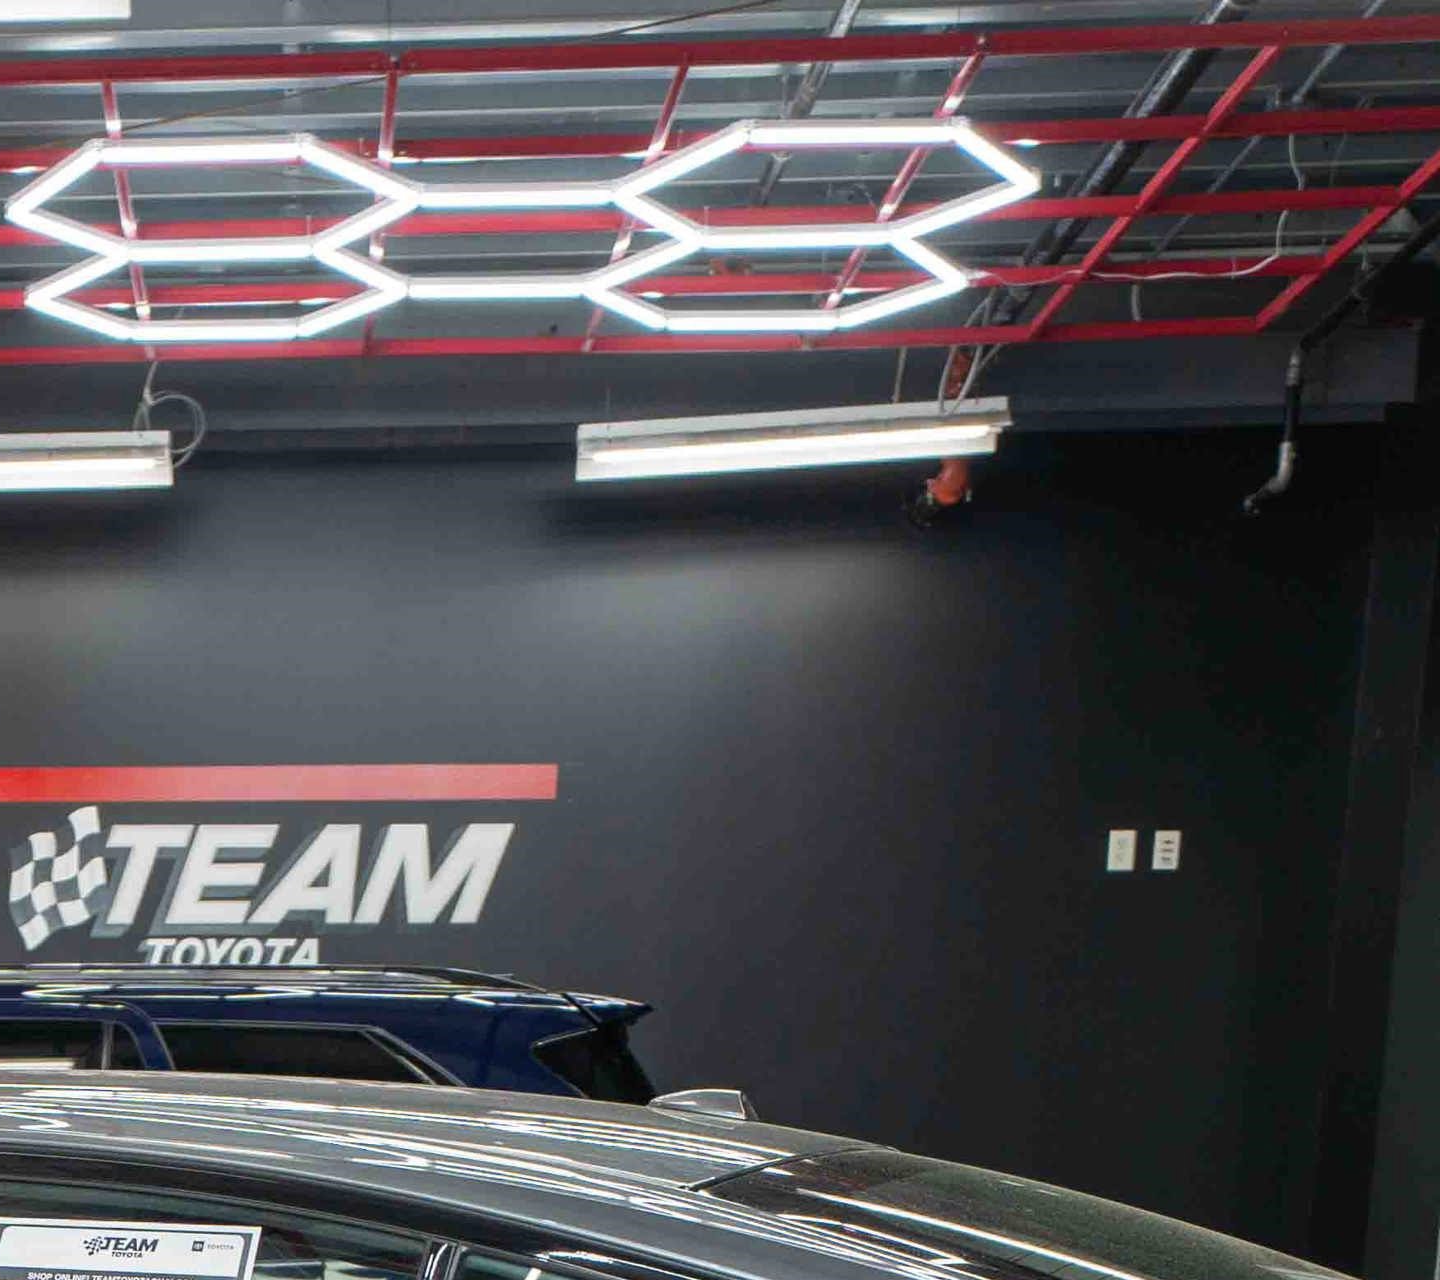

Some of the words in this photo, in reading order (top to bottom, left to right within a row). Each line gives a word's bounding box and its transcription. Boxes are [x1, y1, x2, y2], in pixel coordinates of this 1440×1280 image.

[98, 821, 516, 930] TEAM
[140, 938, 320, 965] TOYOTA
[101, 1236, 159, 1252] TEAM
[27, 1271, 53, 1280] SHOP
